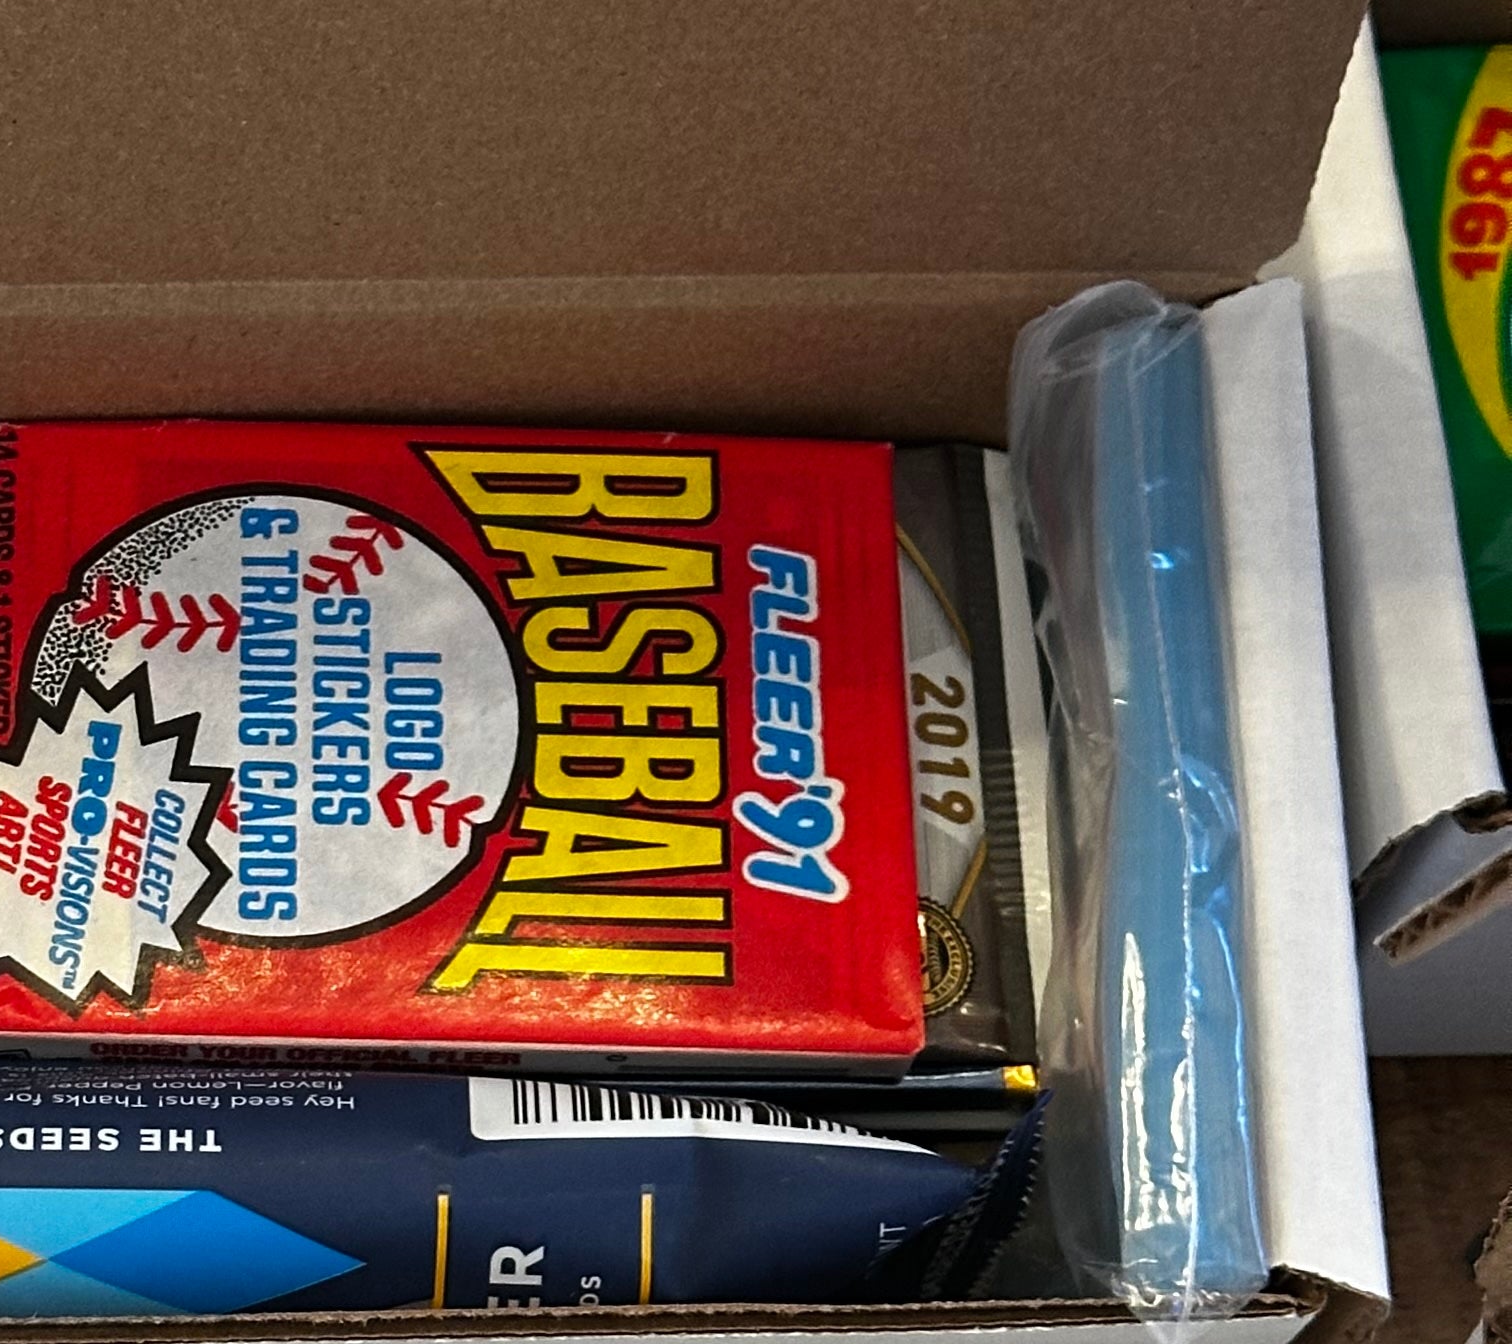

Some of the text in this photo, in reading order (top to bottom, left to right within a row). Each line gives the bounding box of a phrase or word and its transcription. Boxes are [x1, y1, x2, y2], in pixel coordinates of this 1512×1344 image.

[238, 508, 300, 922] & TRADING CARDS
[311, 596, 372, 826] STICKERS
[384, 651, 444, 771] LOGO
[421, 449, 726, 992] BASEBALL
[909, 675, 975, 826] 2019
[19, 775, 73, 902] SPORTS
[101, 800, 149, 901] FLEER
[137, 789, 186, 925] COLLECT
[4, 1091, 43, 1106] for
[52, 1092, 149, 1107] Thanks
[139, 1128, 223, 1153] THE
[158, 1094, 220, 1109] fans!
[231, 1094, 294, 1109] seed
[304, 1093, 355, 1109] Hey
